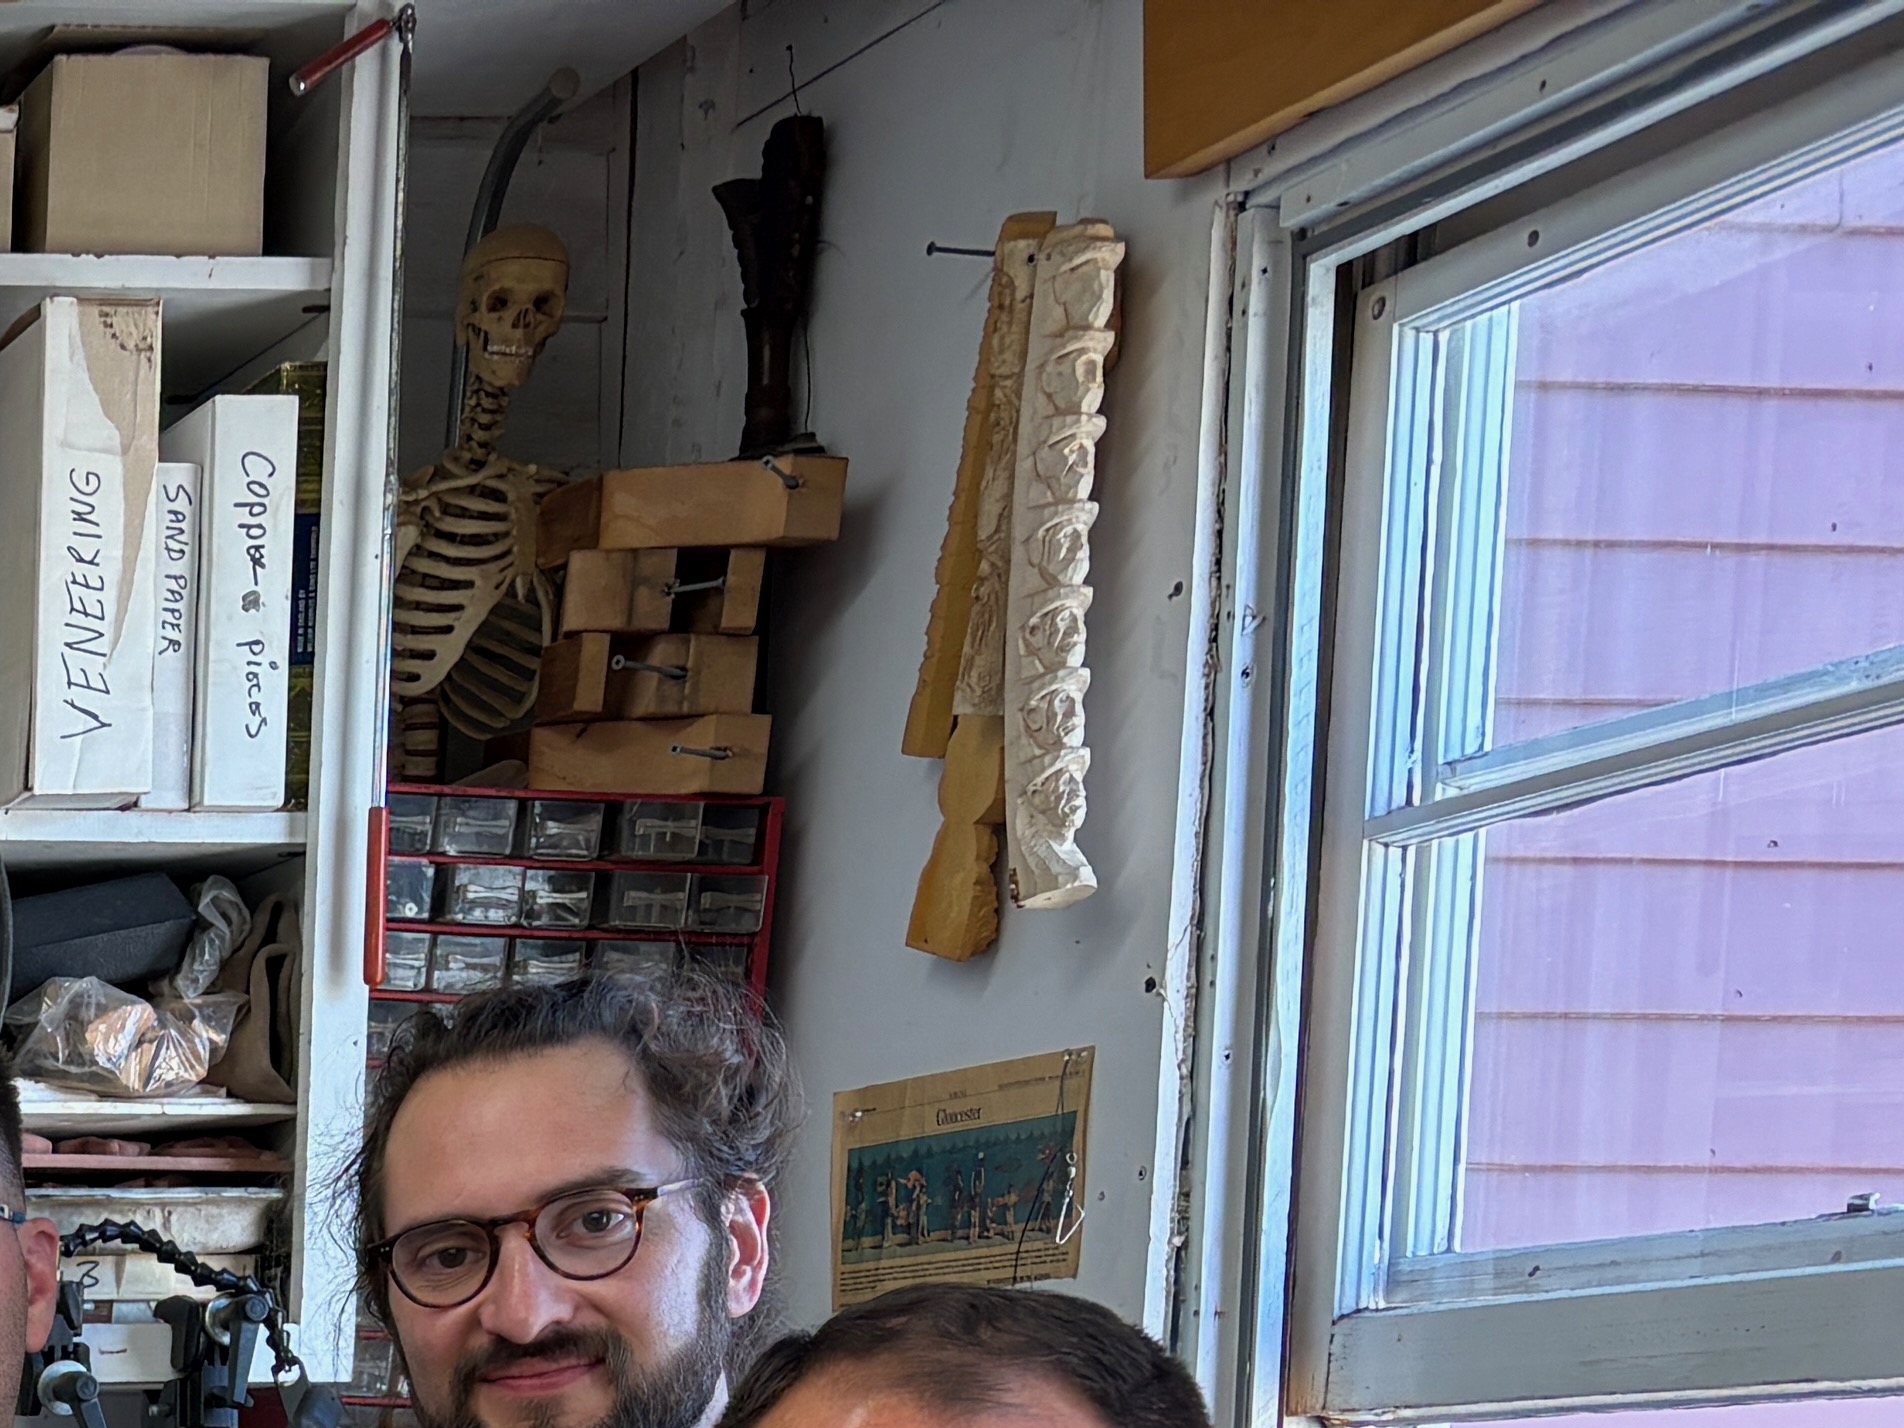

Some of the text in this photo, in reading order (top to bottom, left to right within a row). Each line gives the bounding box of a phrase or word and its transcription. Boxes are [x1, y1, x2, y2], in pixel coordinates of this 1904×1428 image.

[60, 468, 113, 741] VENEERING
[159, 483, 192, 656] SAND PAPER
[936, 1106, 983, 1128] Gloucester
